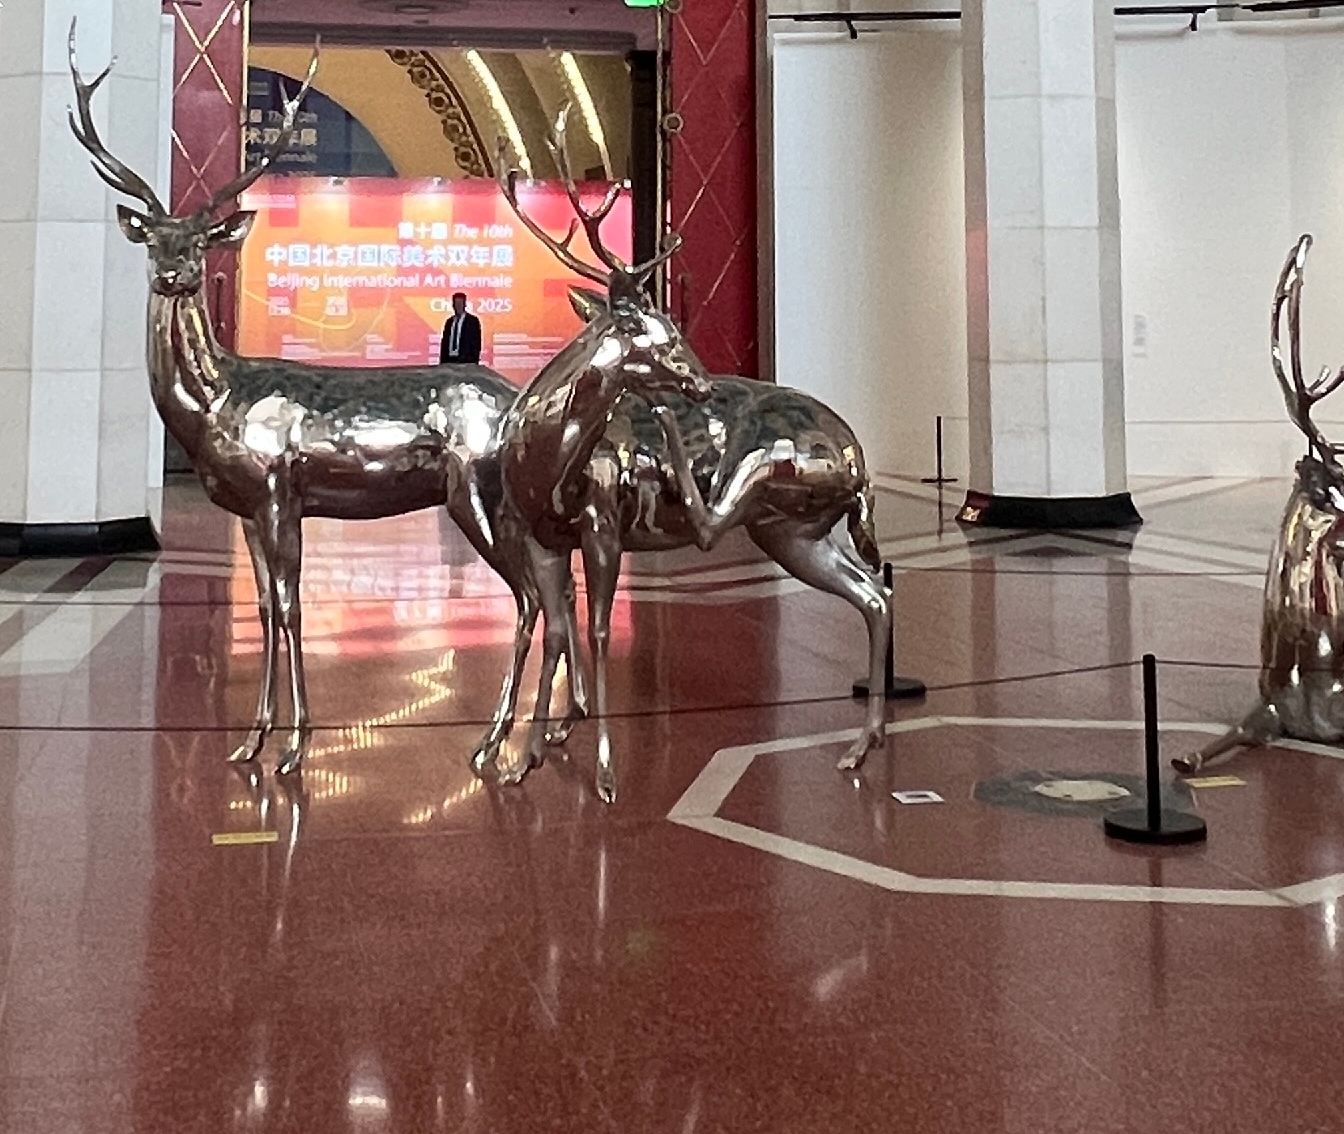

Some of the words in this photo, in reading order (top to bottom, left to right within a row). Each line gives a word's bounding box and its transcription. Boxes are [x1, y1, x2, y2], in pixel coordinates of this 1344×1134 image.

[453, 224, 479, 239] The
[483, 224, 513, 239] 10th
[265, 244, 514, 267] 中国北京国际美术双年展
[267, 272, 320, 291] Beijing
[323, 273, 420, 288] International
[423, 273, 446, 288] Art
[449, 273, 513, 288] Biennale
[430, 297, 473, 313] Cha
[477, 297, 513, 313] 2025
